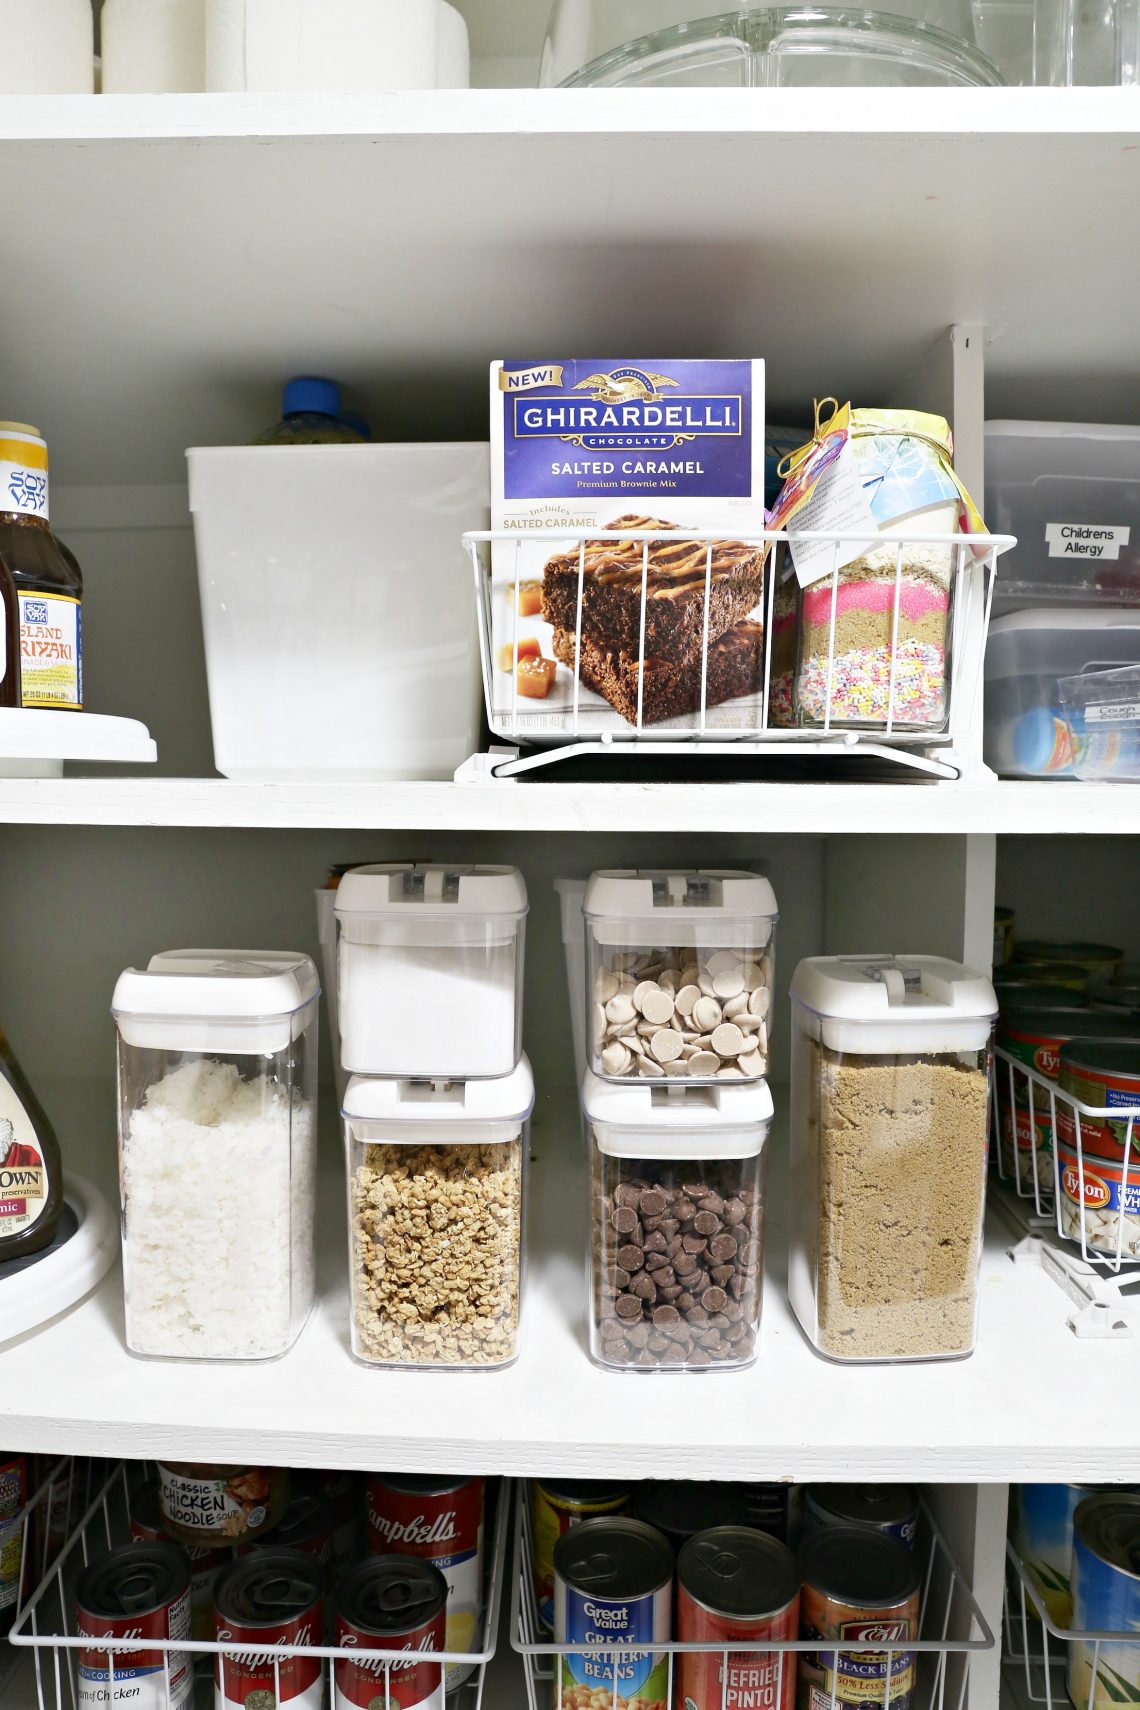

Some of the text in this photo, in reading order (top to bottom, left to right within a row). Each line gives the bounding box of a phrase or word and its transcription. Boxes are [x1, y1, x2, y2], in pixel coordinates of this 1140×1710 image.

[508, 370, 553, 388] NEW!
[524, 405, 733, 428] GHIRARDELLI
[589, 437, 667, 445] CHOCOLATE
[551, 460, 704, 475] SALTED CARAMEL
[8, 471, 46, 492] SOY
[576, 479, 677, 488] Premium Brownie Mix
[10, 488, 46, 510] VAY
[529, 504, 571, 517] Includes
[503, 518, 598, 529] SALTED CARAMEL
[1061, 527, 1114, 540] Childrens
[1064, 542, 1104, 557] Allergy
[20, 625, 62, 639] SLAND
[20, 640, 72, 660] RIYAKI
[1100, 706, 1135, 716] Cough
[1066, 1171, 1105, 1199] Tyon
[2, 1189, 41, 1199] preservatives
[216, 1509, 239, 1521] SOUP
[583, 1602, 629, 1620] Great
[593, 1618, 628, 1629] Value
[230, 1666, 294, 1679] CONDENED
[584, 1661, 635, 1680] BEANS
[837, 1659, 877, 1674] BLACK
[354, 1672, 417, 1684] CONDNSED
[838, 1676, 857, 1689] 50%
[859, 1681, 879, 1690] Less
[97, 1687, 140, 1701] Chcken
[726, 1686, 774, 1708] PINTO
[843, 1689, 867, 1698] Premium
